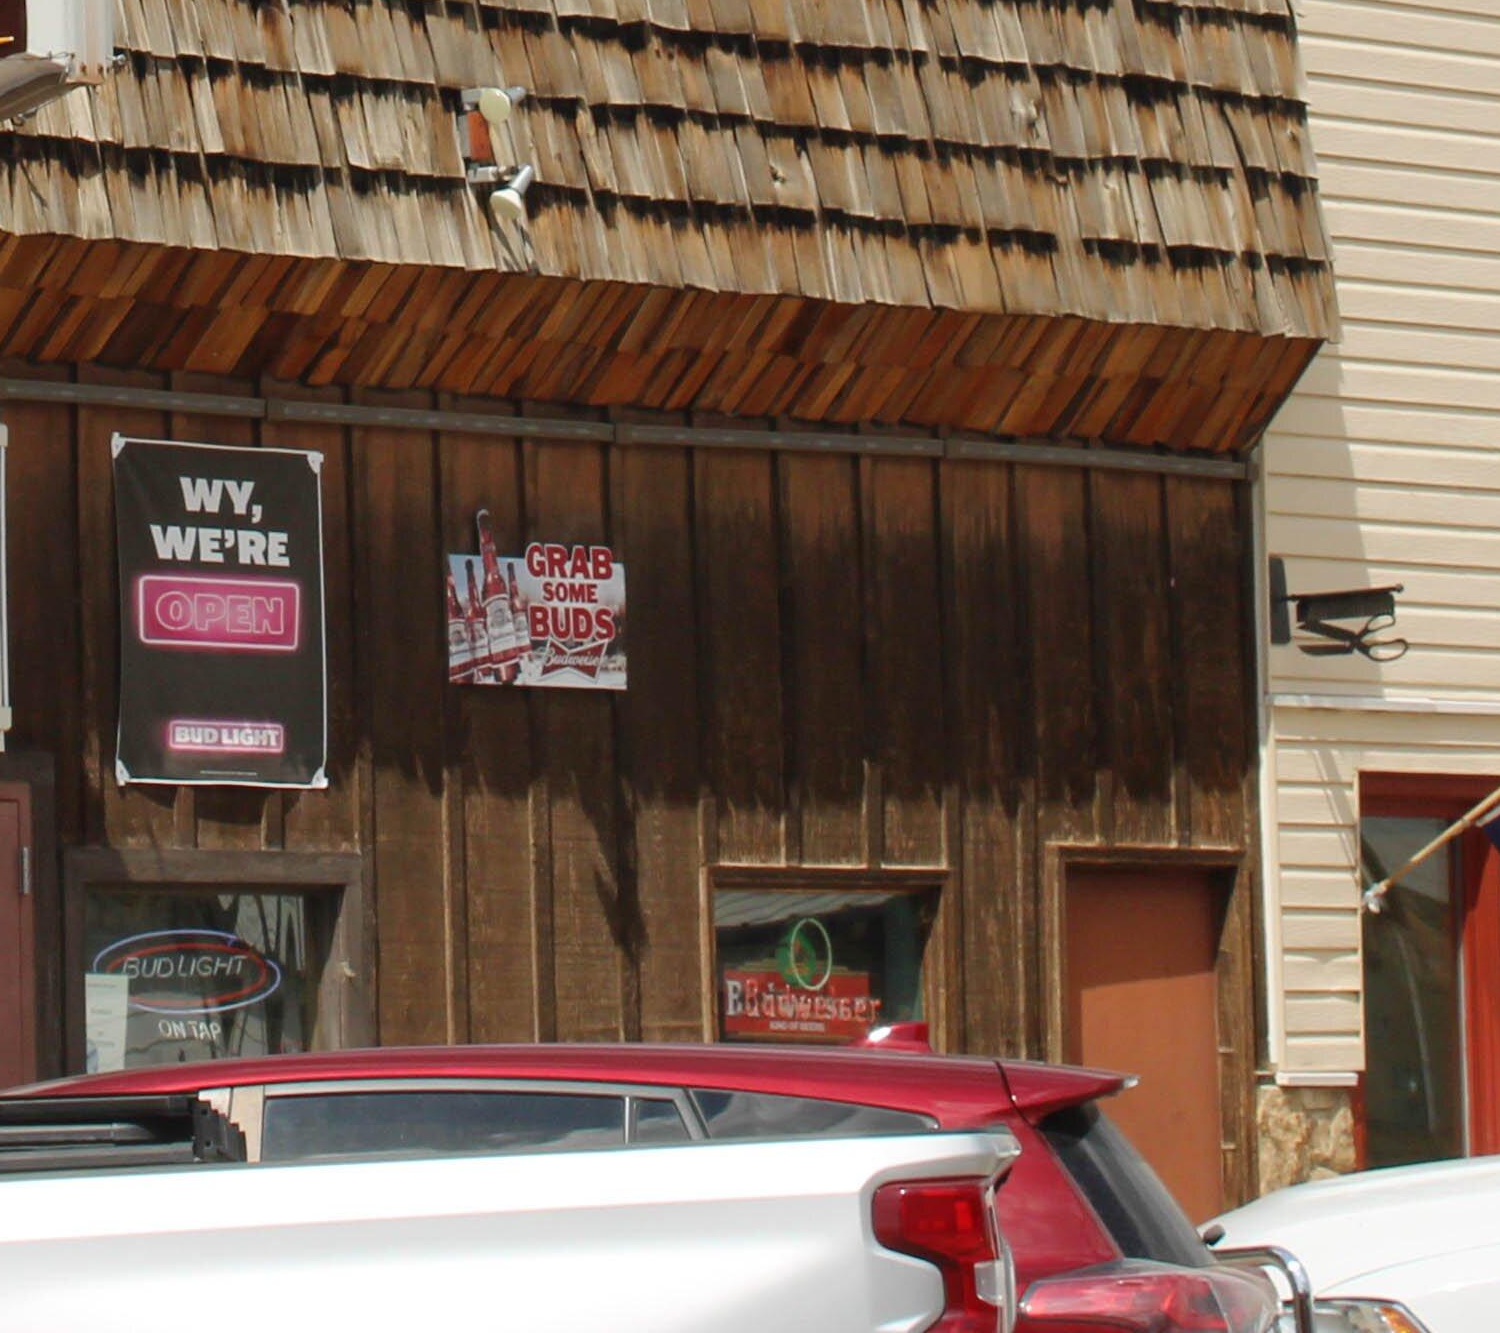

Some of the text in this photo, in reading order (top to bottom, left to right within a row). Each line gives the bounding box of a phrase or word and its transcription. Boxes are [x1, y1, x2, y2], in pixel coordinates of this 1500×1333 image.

[179, 476, 263, 524] WY,
[150, 524, 290, 567] WE'RE
[526, 544, 613, 580] GRAB
[543, 581, 598, 603] SOME
[155, 590, 284, 635] OPEN
[529, 605, 614, 641] BUDS
[175, 726, 279, 746] BUD LIGHT
[122, 954, 248, 979] BUD LIGHT
[158, 1019, 222, 1040] ON TAP
